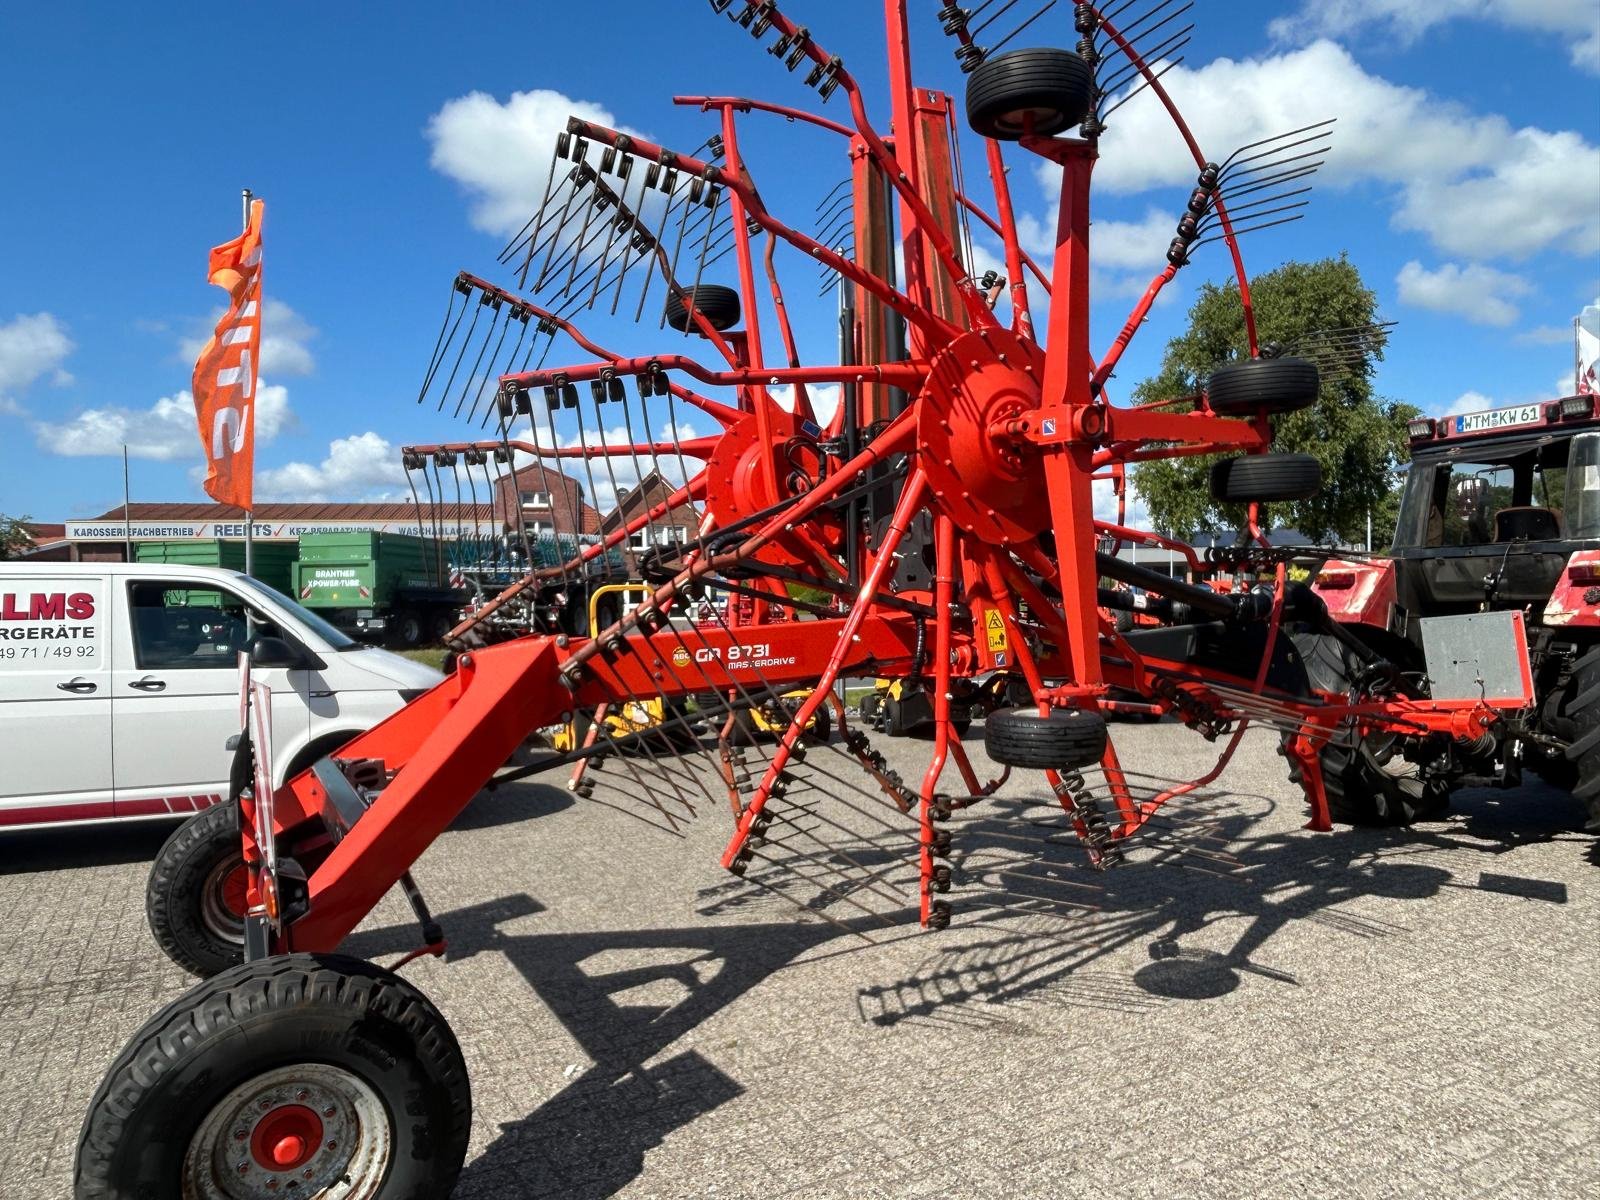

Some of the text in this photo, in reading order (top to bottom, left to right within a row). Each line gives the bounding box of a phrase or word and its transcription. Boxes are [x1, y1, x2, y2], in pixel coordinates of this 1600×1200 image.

[1464, 407, 1538, 430] WTM KW 61
[73, 526, 194, 537] KAROSSERIEFACHBETRIEB
[0, 592, 95, 621] LMS
[0, 624, 95, 640] RGERÄTE
[20, 647, 38, 659] 71
[53, 646, 72, 658] 49
[76, 645, 96, 657] 92
